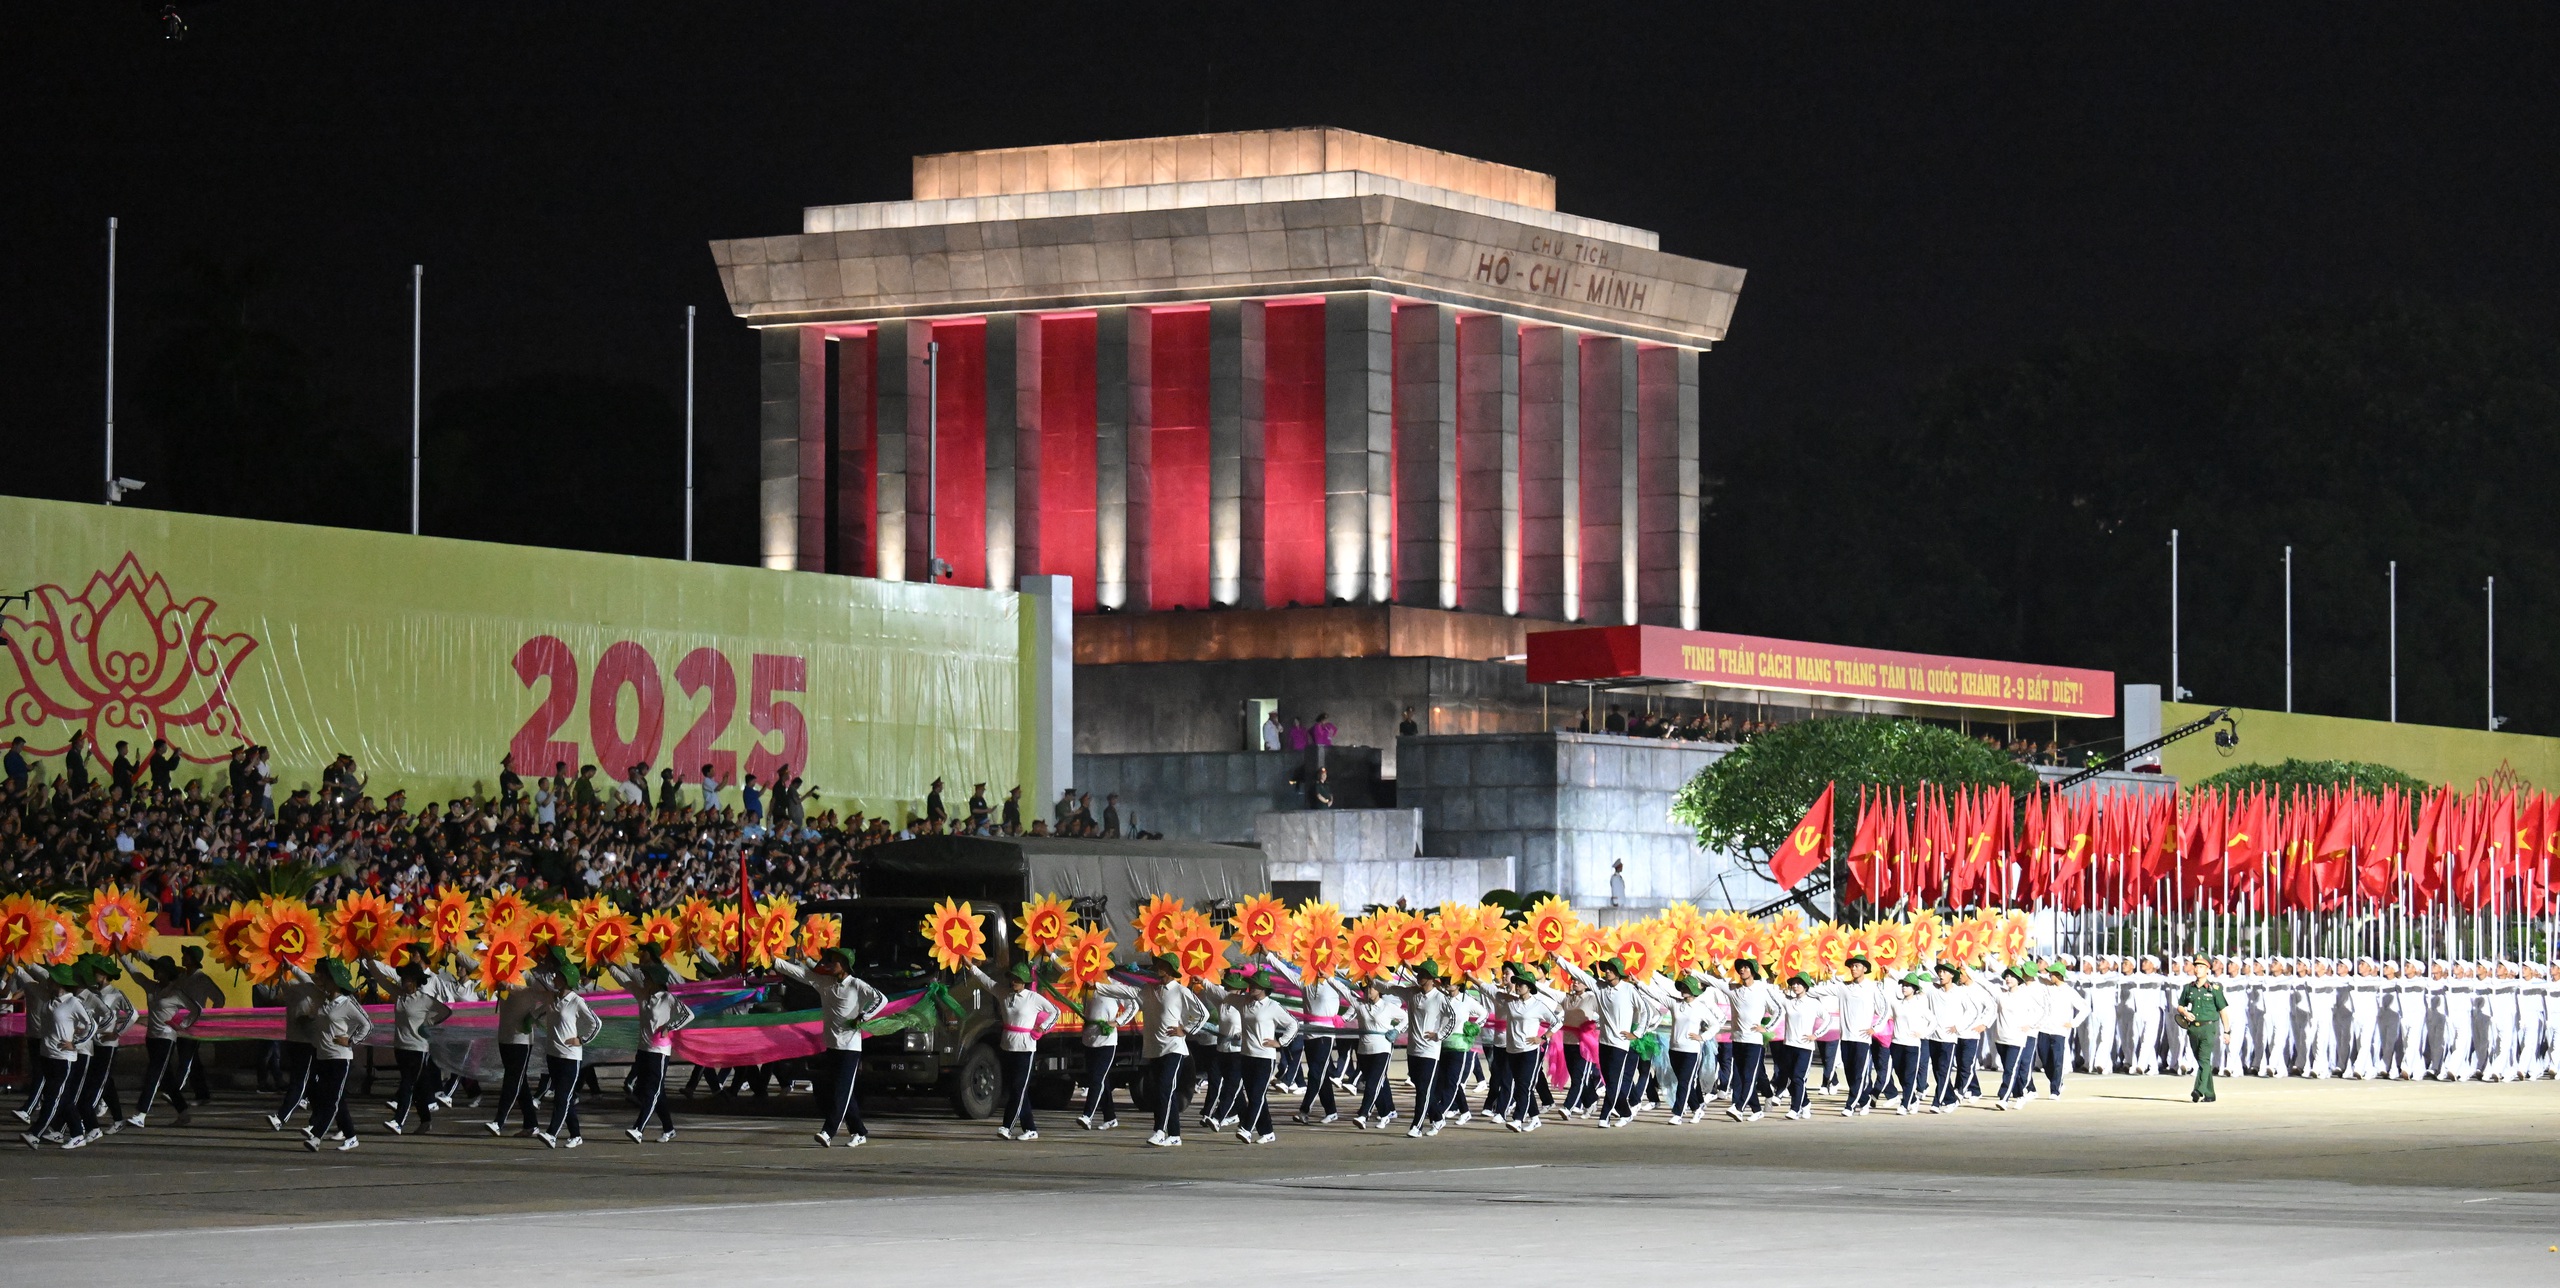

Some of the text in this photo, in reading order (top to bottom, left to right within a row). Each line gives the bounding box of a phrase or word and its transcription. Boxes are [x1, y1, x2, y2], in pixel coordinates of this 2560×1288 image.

[1681, 643, 2084, 708] TINH THẦN CÁCH MẠNG THÁNG TÁM VÀ QUỐC KHÁNH 2-9 BẤT DIỆT!
[509, 634, 809, 790] 2025
[972, 988, 981, 1010] 10
